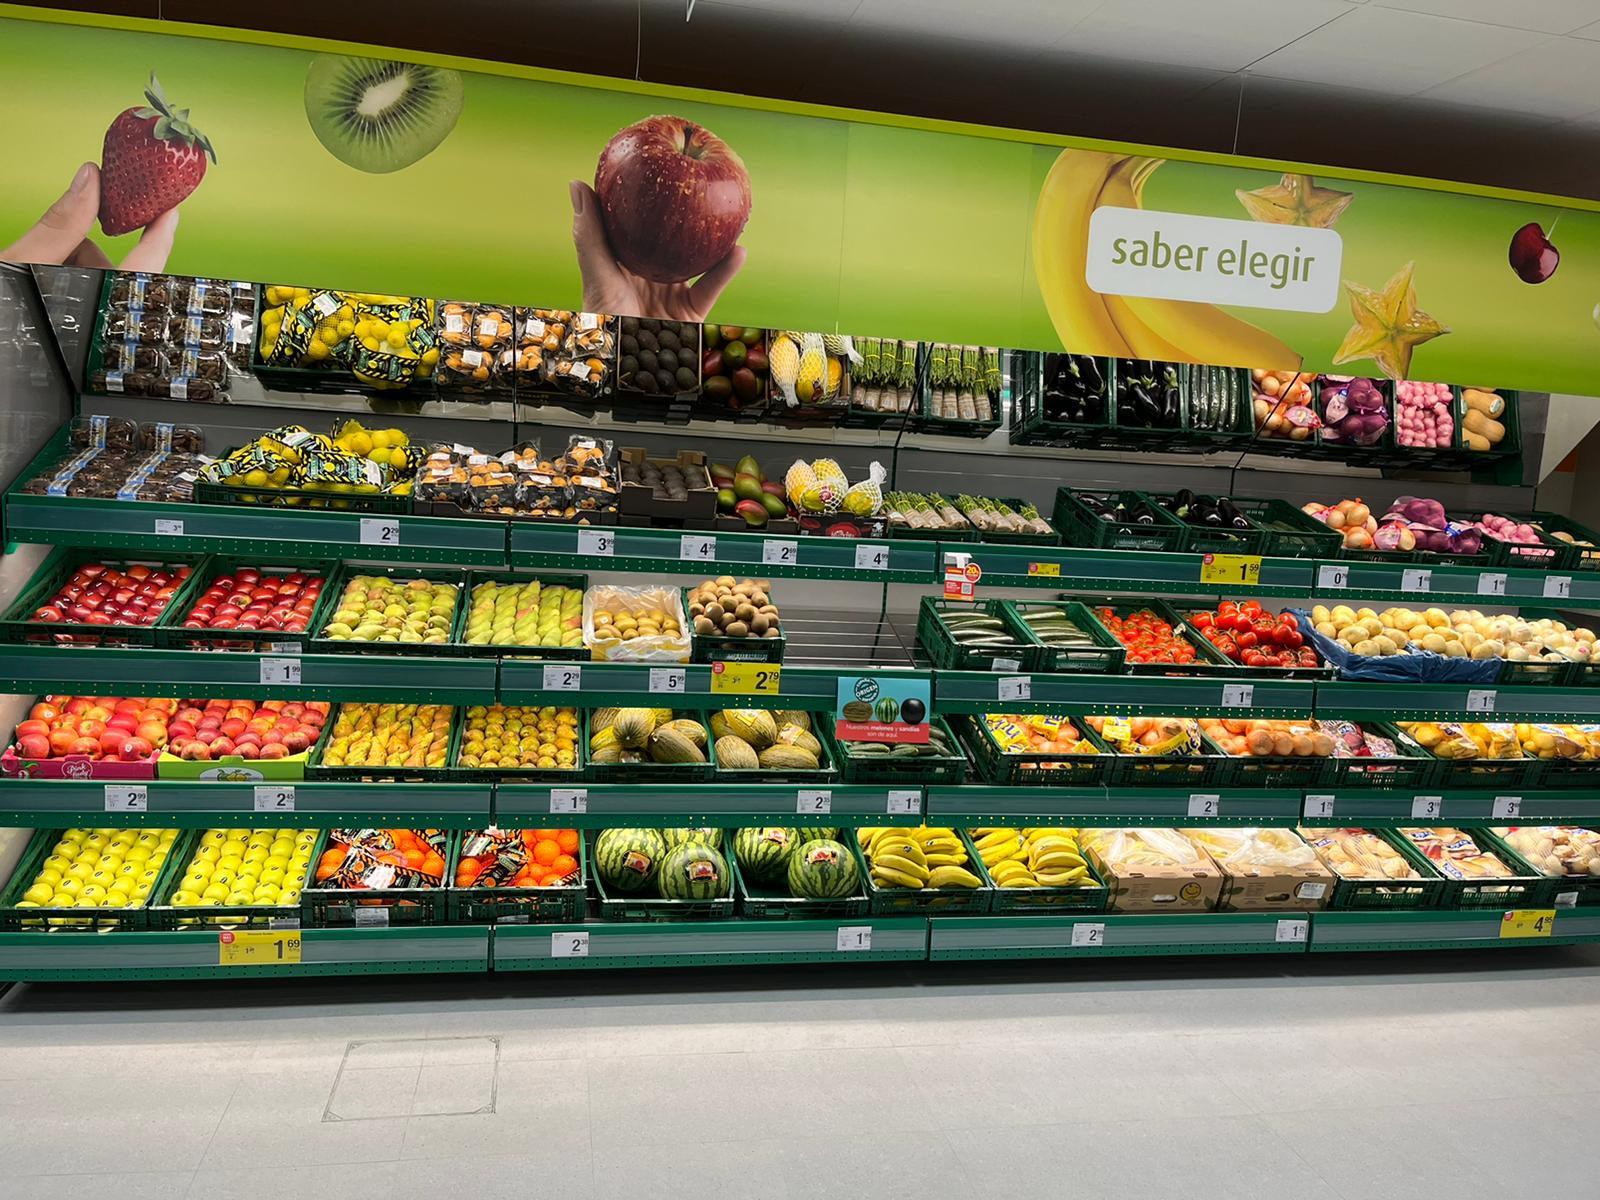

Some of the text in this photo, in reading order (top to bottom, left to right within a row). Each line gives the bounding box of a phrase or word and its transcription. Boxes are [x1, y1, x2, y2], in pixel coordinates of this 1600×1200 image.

[1112, 231, 1315, 289] saber elegir
[855, 684, 879, 698] ORIGEN
